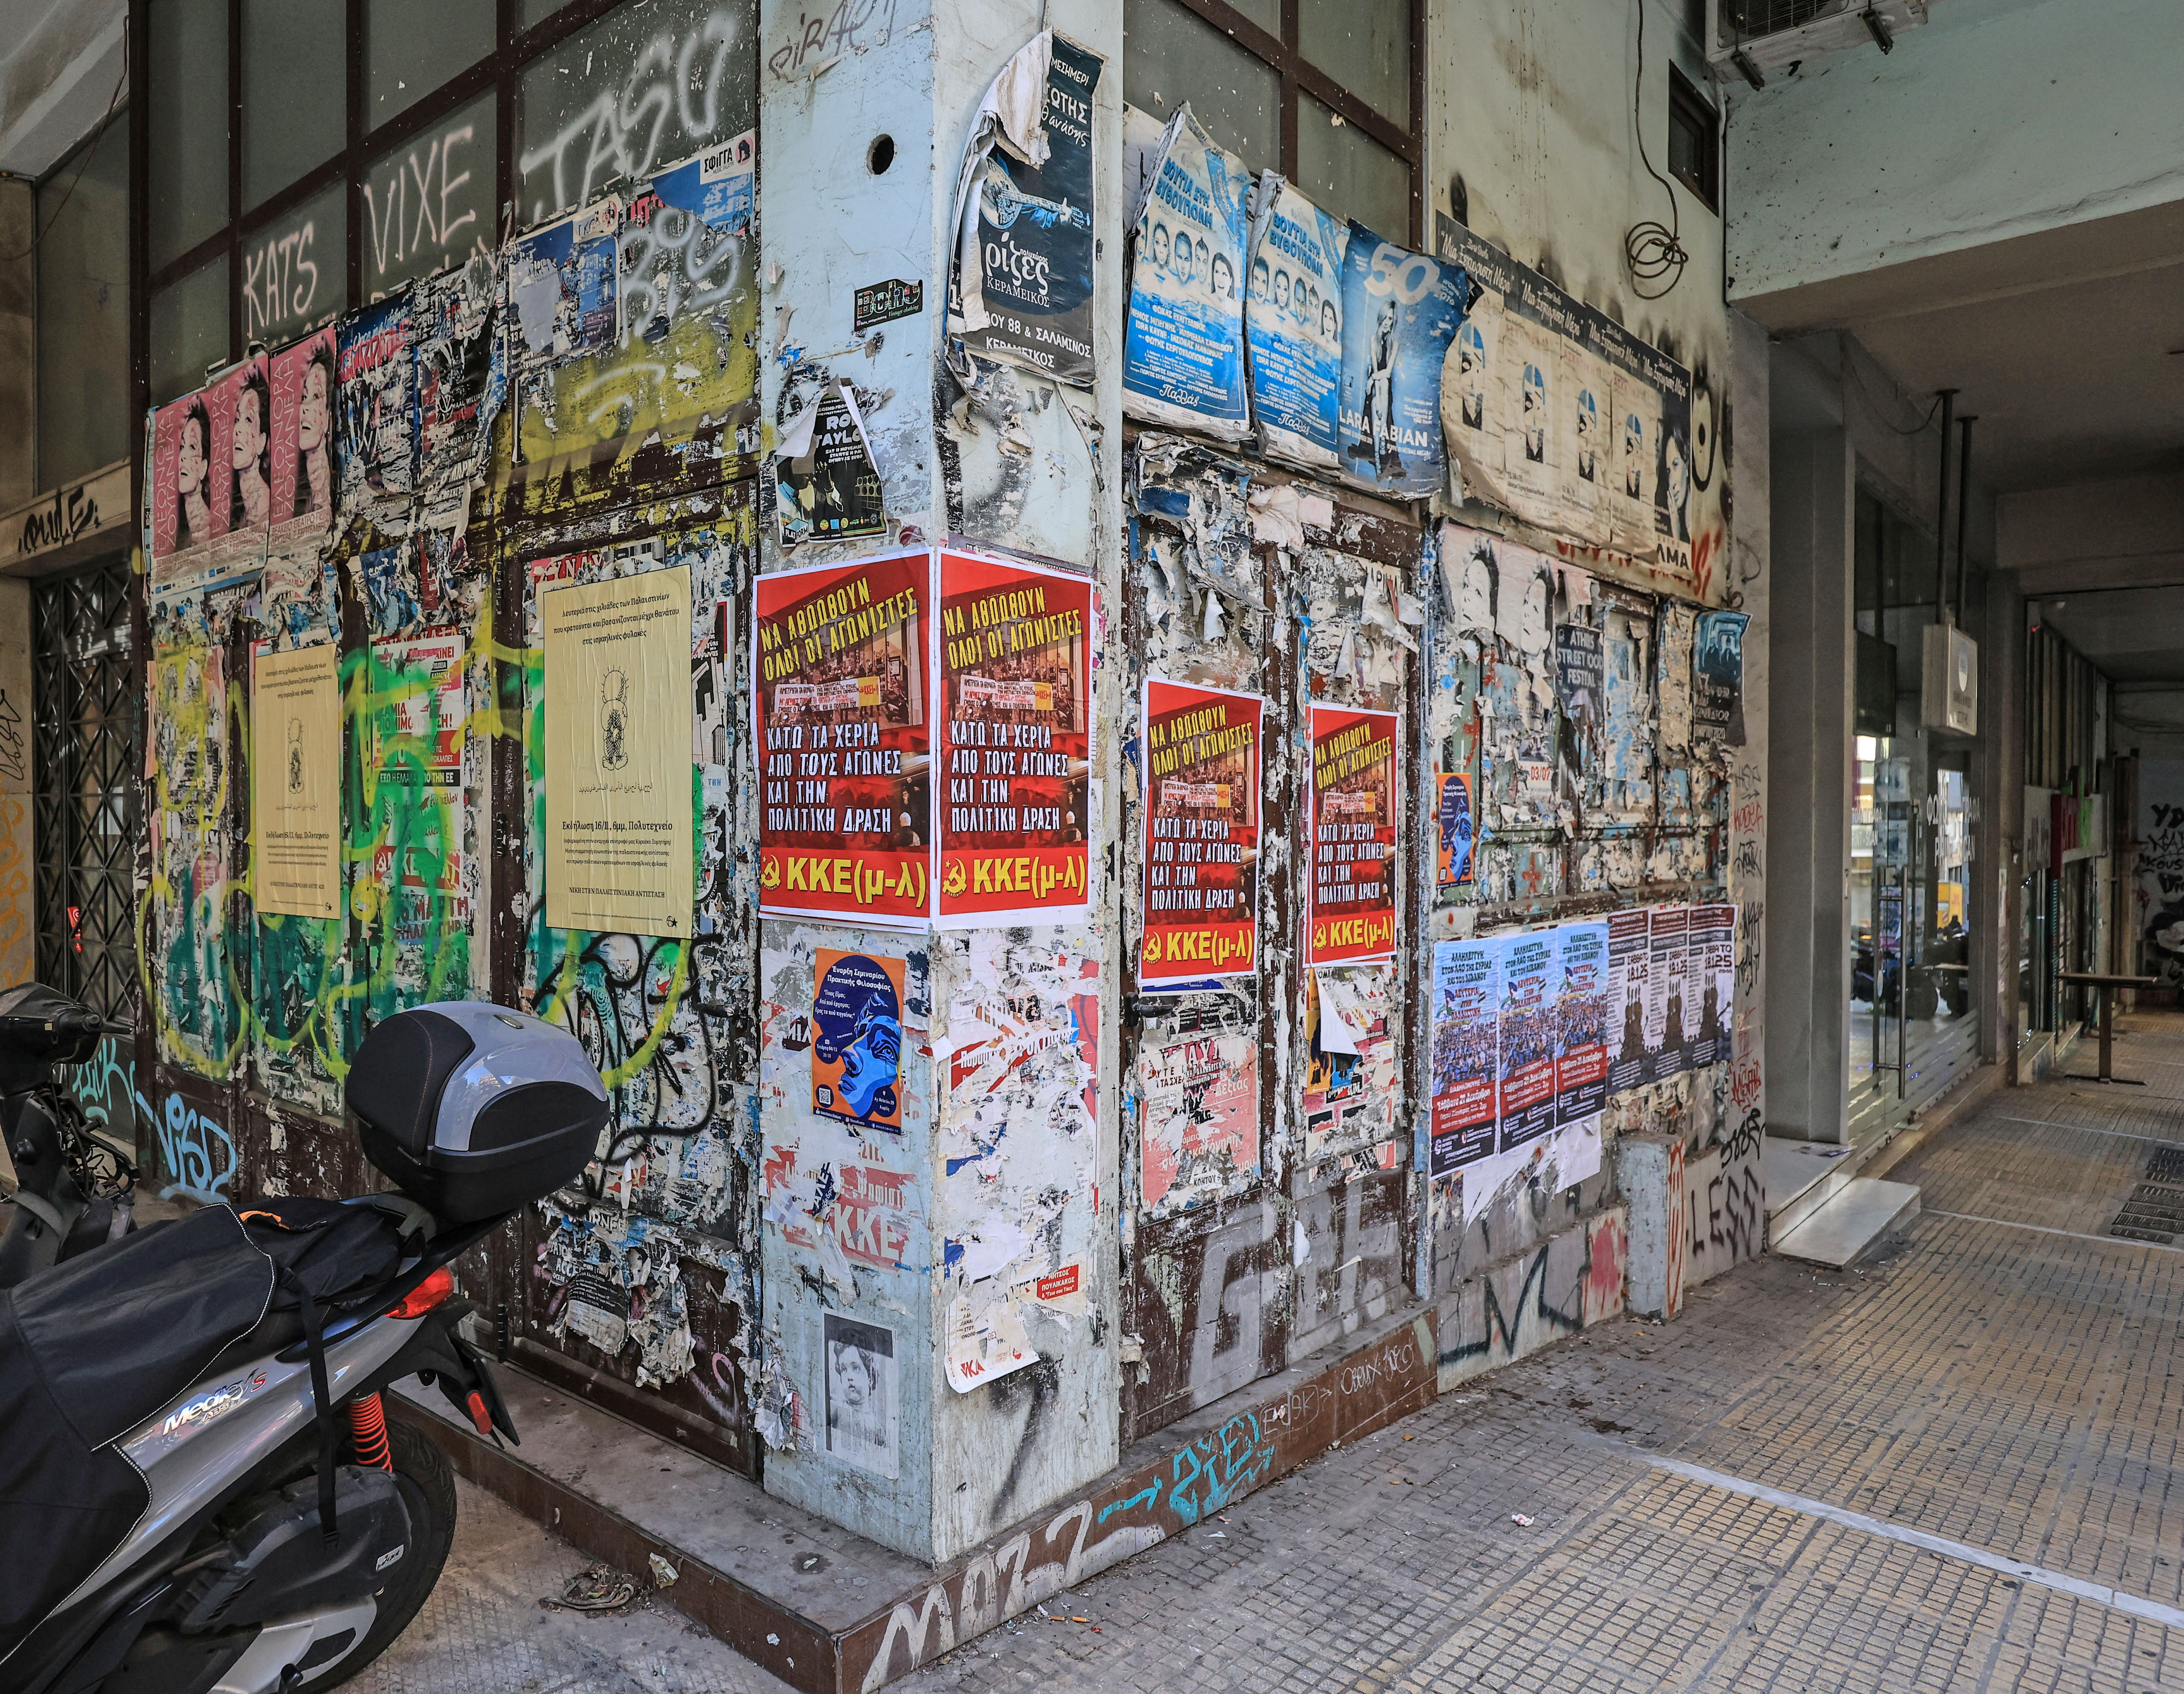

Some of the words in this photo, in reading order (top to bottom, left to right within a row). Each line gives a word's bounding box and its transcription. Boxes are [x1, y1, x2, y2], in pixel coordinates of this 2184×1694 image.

[1051, 56, 1090, 86] ΜΕΣΗΜΕΡΙ
[723, 160, 734, 170] THEATRE
[1163, 157, 1194, 196] ΒΟΥΤΙΑ
[1194, 186, 1210, 208] ΣΤΗ
[364, 126, 476, 274] VIXE
[1155, 177, 1213, 229] ΒΥΘΟΥΠΟΛΗ
[1274, 212, 1307, 248] ΒΟΥΤΙΑ
[1308, 239, 1320, 258] ΣΤΗ
[985, 232, 1049, 295] ρίζες
[1020, 248, 1049, 265] πολυχώρος
[1270, 229, 1323, 278] ΒΥΘΟΥΠΟΛΗ
[244, 222, 318, 339] KATS
[1363, 243, 1440, 304] 50
[857, 281, 920, 319] Boho
[987, 276, 1050, 308] ΚΕΡΑΜΕΙΚΟΣ
[903, 304, 919, 314] clothing
[1008, 318, 1021, 334] 88
[1024, 326, 1031, 338] &
[1036, 327, 1091, 358] ΣΑΛΑΜΙΝΟΣ
[1339, 405, 1370, 434] LARA
[1373, 420, 1427, 447] FABIAN
[562, 606, 585, 617] Λευτεριά
[597, 602, 619, 613] χιλιάδες
[631, 593, 669, 606] Παλαιστινίων
[761, 622, 782, 652] ΝΑ
[788, 577, 870, 640] ΑΘΩΩΘΟΥΝ
[944, 606, 965, 636] ΝΑ
[972, 587, 1045, 629] ΑΘΩΩΘΟΥΝ
[564, 623, 592, 633] κρατούνται
[602, 615, 638, 628] βασανίζονται
[654, 609, 679, 617] θανάτου
[764, 643, 800, 681] ΟΛΟΙ
[805, 632, 823, 663] ΟΙ
[830, 587, 917, 653] ΑΓΩΝΙΣΤΕΣ
[594, 634, 622, 644] ισραηλινές
[623, 629, 647, 640] φυλακές
[948, 634, 982, 670] ΟΛΟΙ
[988, 629, 1004, 658] ΟΙ
[1011, 609, 1082, 652] ΑΓΩΝΙΣΤΕΣ
[767, 723, 802, 750] ΚΑΤΩ
[812, 725, 827, 749] ΤΑ
[835, 722, 879, 748] ΧΕΡΙΑ
[951, 721, 985, 745] ΚΑΤΩ
[992, 723, 1008, 746] ΤΑ
[1014, 723, 1051, 748] ΧΕΡΙΑ
[1150, 723, 1166, 749] ΝΑ
[1153, 745, 1179, 776] ΟΛΟΙ
[1182, 741, 1194, 765] ΟΙ
[1200, 722, 1254, 760] ΑΓΩΝΙΣΤΕΣ
[1315, 744, 1326, 767] ΝΑ
[1317, 762, 1337, 789] ΟΛΟΙ
[1339, 756, 1348, 778] ΟΙ
[1351, 736, 1391, 773] ΑΓΩΝΙΣΤΕΣ
[768, 754, 792, 776] ΑΠΟ
[800, 753, 837, 776] ΤΟΥΣ
[845, 750, 901, 775] ΑΓΩΝΕΣ
[951, 750, 978, 774] ΑΠΟ
[984, 751, 1016, 775] ΤΟΥΣ
[1022, 751, 1068, 776] ΑΓΩΝΕΣ
[768, 779, 788, 804] ΚΑΙ
[796, 781, 827, 804] ΤΗΝ
[951, 778, 974, 803] ΚΑΙ
[981, 779, 1008, 804] ΤΗΝ
[562, 821, 594, 832] Εκδήλωση
[629, 820, 672, 832] Πολυτεχνείο
[768, 807, 835, 832] ΠΟΛΙΤΙΚΗ
[842, 807, 891, 834] ΔΡΑΣΗ
[952, 806, 1016, 832] ΠΟΛΙΤΙΚΗ
[1022, 806, 1060, 833] ΔΡΑΣΗ
[787, 857, 925, 908] ΚΚΕ(μ-λ)
[974, 855, 1085, 899] ΚΚΕ(μ-λ)
[595, 888, 635, 897] ΠΑΛΑΙΣΤΙΝΙΑΚΗ
[827, 975, 855, 987] Πρακτικής
[856, 979, 891, 992] Φιλοσοφίας
[832, 965, 853, 977] Έναρξη
[854, 970, 885, 980] Σεμιναρίου
[815, 1007, 824, 1015] Προς
[833, 1000, 850, 1009] έρχομαι;
[817, 1043, 829, 1051] Τετάρτη
[834, 1202, 900, 1261] ΚΚΕ
[1042, 1277, 1075, 1291] ΠΟΥΛΙΚΑΚΟΣ
[250, 1372, 267, 1392] S
[203, 1403, 229, 1422] ABS
